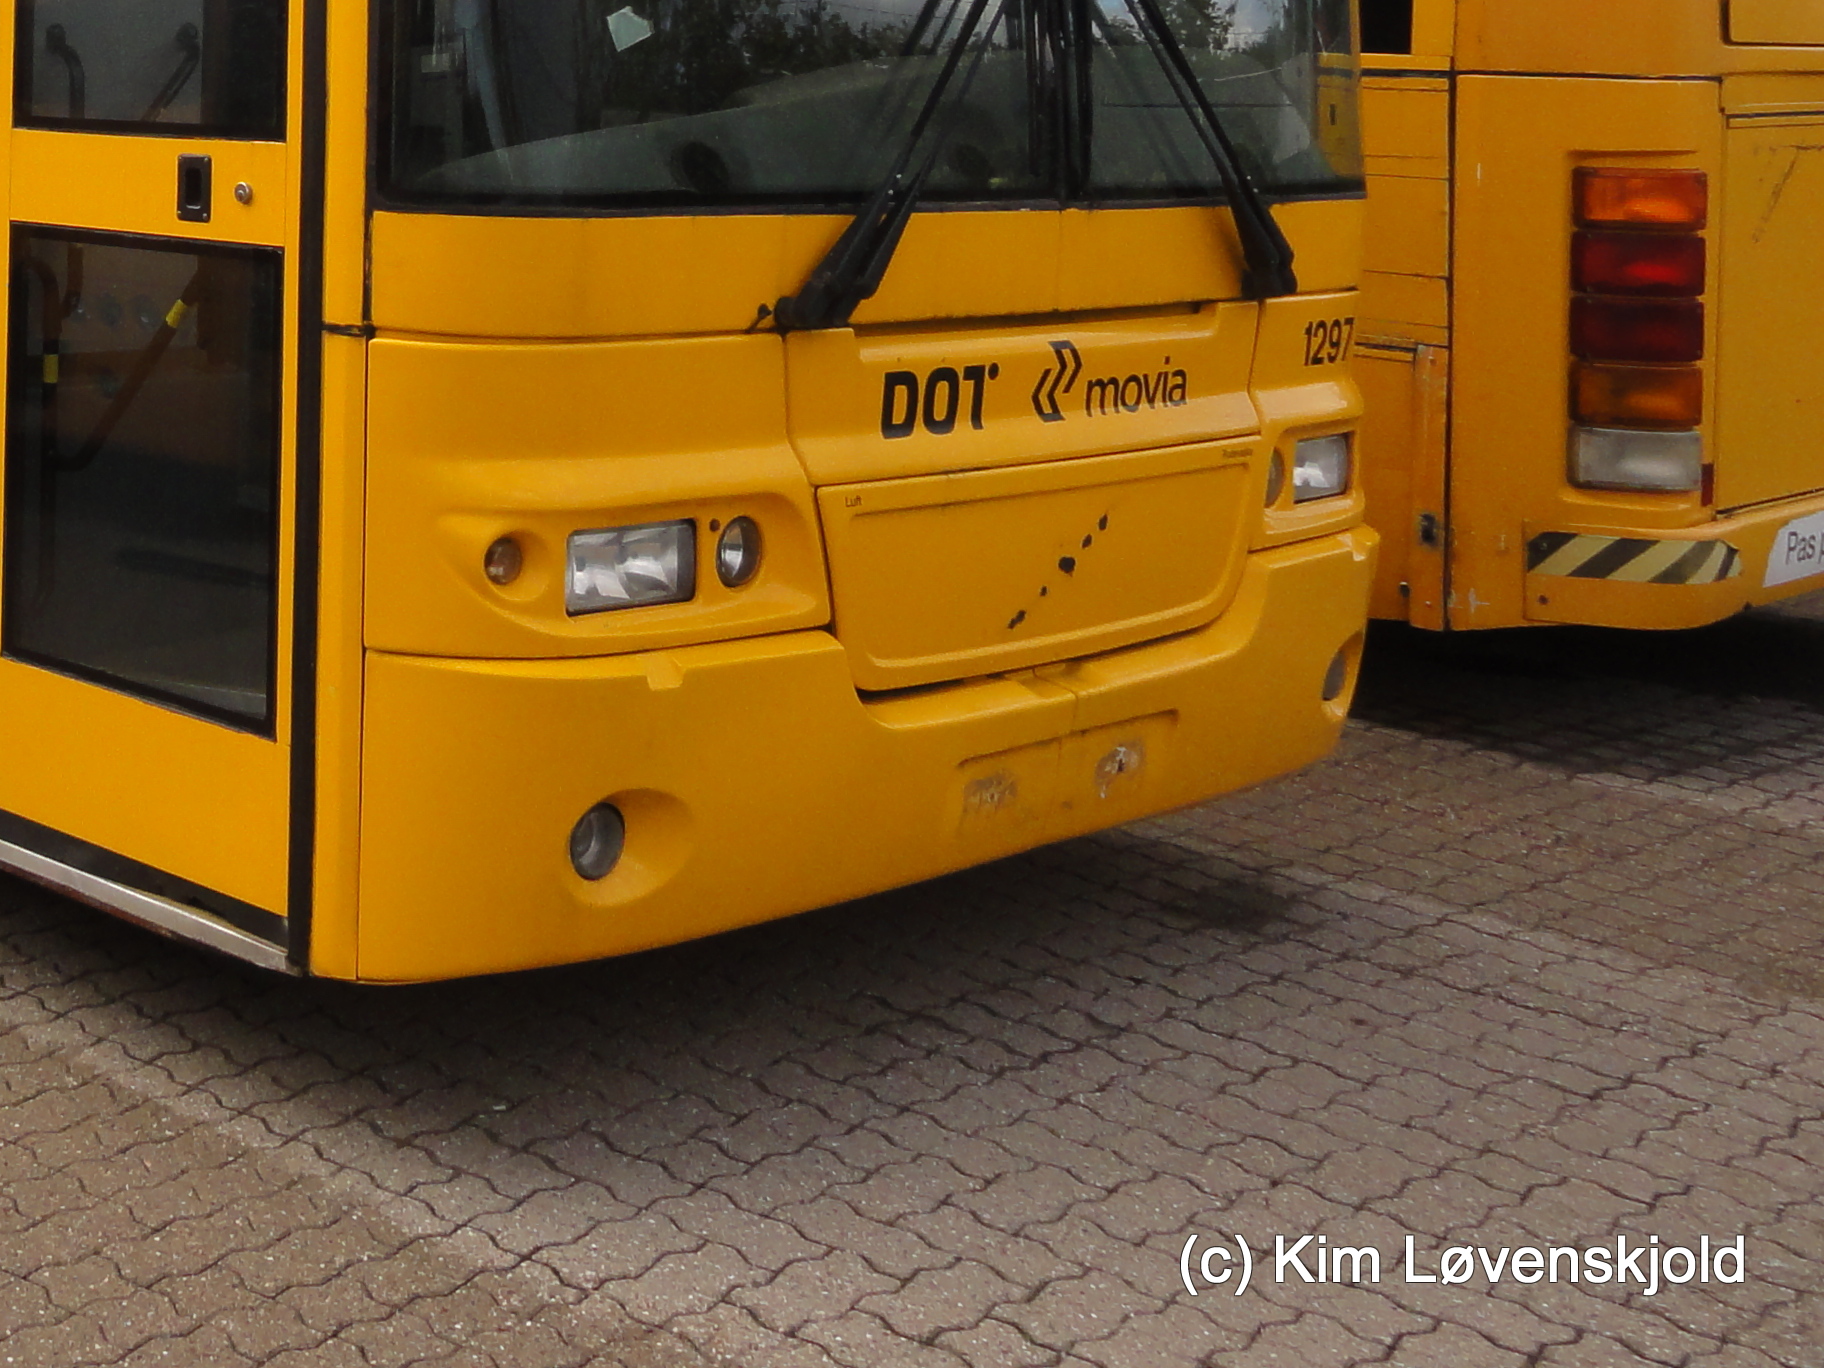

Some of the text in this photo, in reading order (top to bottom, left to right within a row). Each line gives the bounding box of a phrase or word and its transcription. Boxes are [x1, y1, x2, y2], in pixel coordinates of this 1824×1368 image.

[1304, 316, 1355, 367] 1297
[880, 355, 1189, 440] DOT movia
[1785, 531, 1816, 566] Pas
